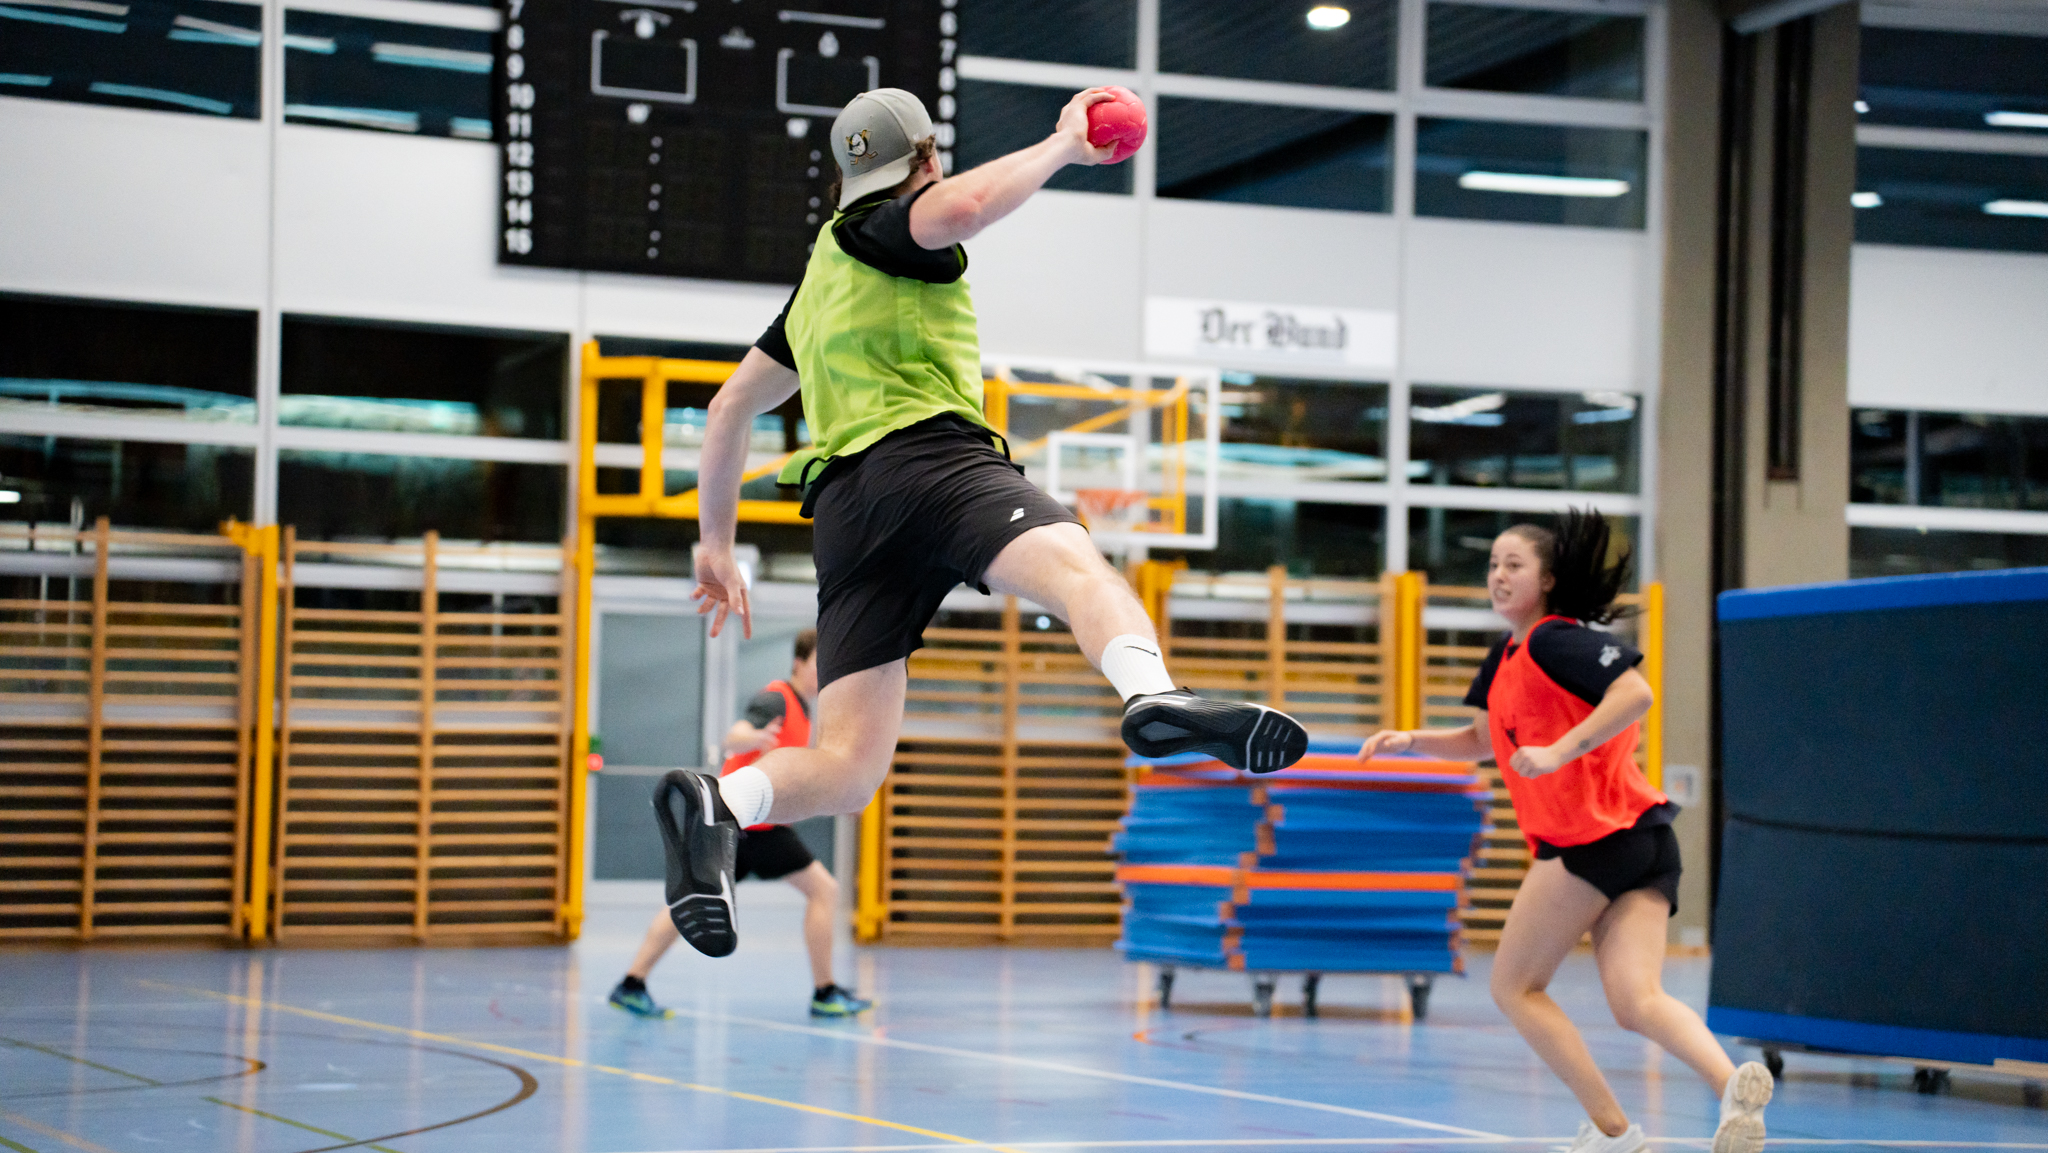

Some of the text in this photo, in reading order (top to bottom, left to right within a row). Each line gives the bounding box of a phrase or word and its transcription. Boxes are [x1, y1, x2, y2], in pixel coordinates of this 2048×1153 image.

[507, 24, 524, 50] 8
[940, 39, 956, 64] 7
[506, 53, 524, 79] 9
[507, 83, 535, 109] 10
[506, 112, 532, 138] 11
[506, 141, 534, 168] 12
[505, 170, 534, 197] 13
[505, 199, 533, 225] 14
[505, 227, 532, 254] 15
[1200, 308, 1346, 349] Der Bund
